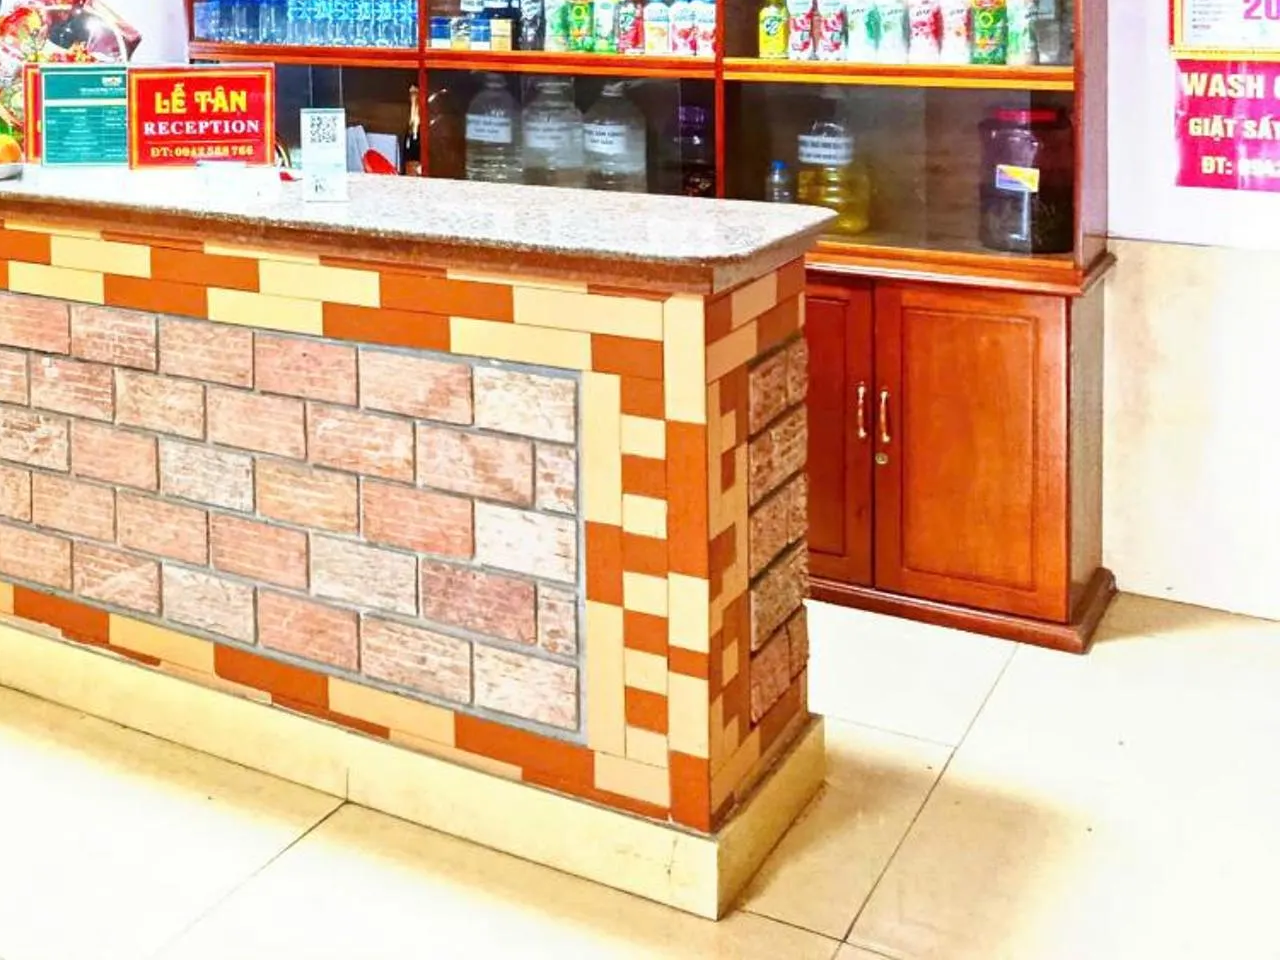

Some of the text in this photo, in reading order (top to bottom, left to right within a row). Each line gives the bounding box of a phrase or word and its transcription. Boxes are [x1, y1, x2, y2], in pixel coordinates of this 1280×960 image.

[155, 83, 248, 114] LỄ TÂN
[1181, 72, 1264, 99] WASH
[144, 119, 260, 136] RECEPTION
